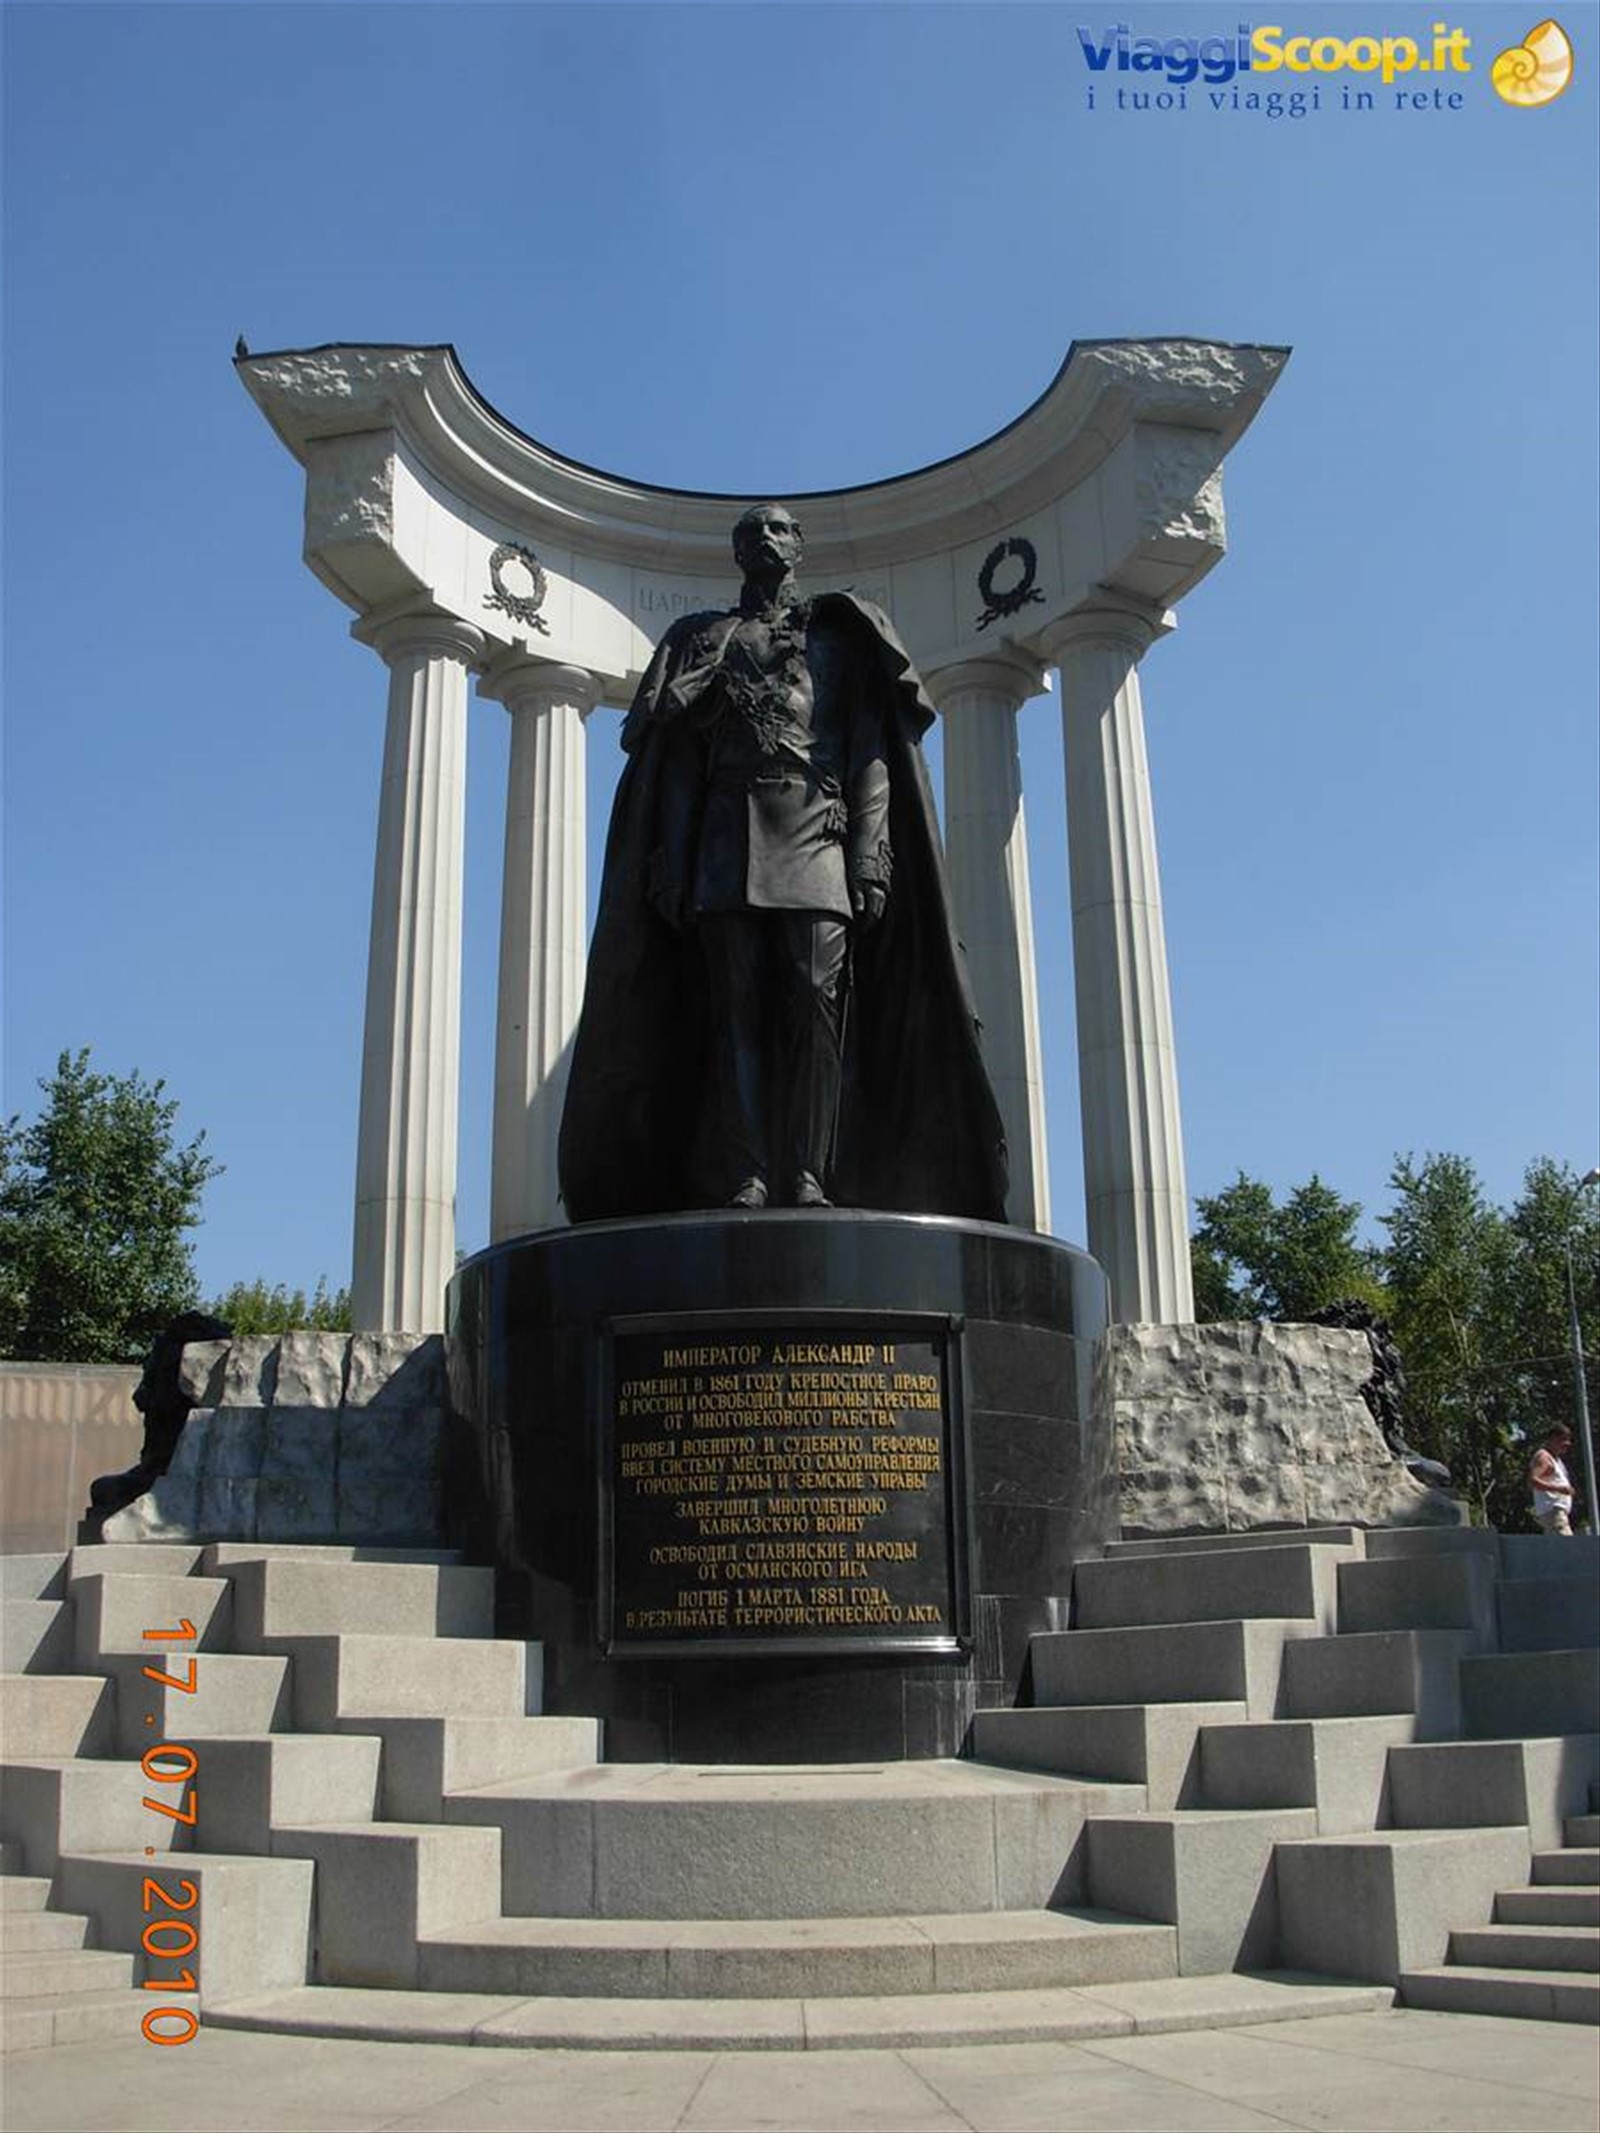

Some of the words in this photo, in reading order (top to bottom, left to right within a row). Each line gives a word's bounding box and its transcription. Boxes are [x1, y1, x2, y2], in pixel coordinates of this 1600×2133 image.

[663, 1345, 761, 1368] ИМПЕРАТОР
[772, 1344, 875, 1365] АЛЕКСАНДР
[622, 1377, 687, 1398] ОТМЕНИЛ
[694, 1377, 703, 1391] В
[710, 1375, 739, 1391] 1861
[745, 1373, 784, 1391] ГОДУ
[791, 1372, 887, 1391] КРЕПОСТНОЕ
[893, 1373, 937, 1391] ПРАВО
[619, 1400, 628, 1415] В
[632, 1396, 683, 1415] РОССИИ
[687, 1395, 697, 1411] И
[699, 1391, 783, 1410] ОСВОБОДИЛ
[788, 1391, 868, 1408] МИЛЛИОНЫ
[873, 1391, 941, 1410] КРЕСТЬЯН
[664, 1414, 683, 1431] ОТ
[693, 1409, 823, 1429] МНОГОВЕКОВОГО
[832, 1409, 897, 1427] РАБСТВА
[621, 1440, 675, 1459] ПРОВЕЛ
[683, 1437, 755, 1456] ВОЕННУЮ
[764, 1436, 775, 1453] И
[783, 1435, 863, 1453] СУДЕБНУЮ
[872, 1435, 939, 1453] РЕФОРМЫ
[621, 1460, 655, 1477] ВВЕЛ
[661, 1456, 726, 1475] СИСТЕМУ
[732, 1454, 811, 1473] МЕСТНОГО
[816, 1453, 940, 1471] САМОУПРАВЛЕНИЯ
[636, 1475, 718, 1494] ГОРОДСКИЕ
[726, 1473, 771, 1492] ДУМЫ
[777, 1473, 788, 1489] И
[797, 1472, 864, 1489] ЗЕМСКИЕ
[870, 1472, 927, 1489] УПРАВЫ
[676, 1499, 759, 1518] ЗАВЕРШИЛ
[767, 1497, 887, 1515] МНОГОЛЕТНЮЮ
[700, 1516, 808, 1535] КАВКАЗСКУЮ
[816, 1515, 865, 1533] ВОЙНУ
[650, 1543, 737, 1564] ОСВОБОДИЛ
[746, 1541, 848, 1560] СЛАВЯНСКИЕ
[855, 1541, 918, 1560] НАРОДЫ
[698, 1563, 718, 1580] ОТ
[725, 1561, 832, 1580] ОСМАНСКОГО
[839, 1561, 868, 1578] ИГА
[678, 1589, 728, 1607] ПОГИБ
[736, 1589, 743, 1605] 1
[749, 1588, 803, 1605] МАРТА
[810, 1587, 844, 1605] 1881
[851, 1587, 891, 1606] ГОДА
[625, 1612, 635, 1628] В
[639, 1609, 727, 1628] РЕЗУЛЬТАТЕ
[734, 1606, 901, 1625] ТЕРРОРИСТИЧЕСКОГО
[906, 1605, 941, 1623] АКТА
